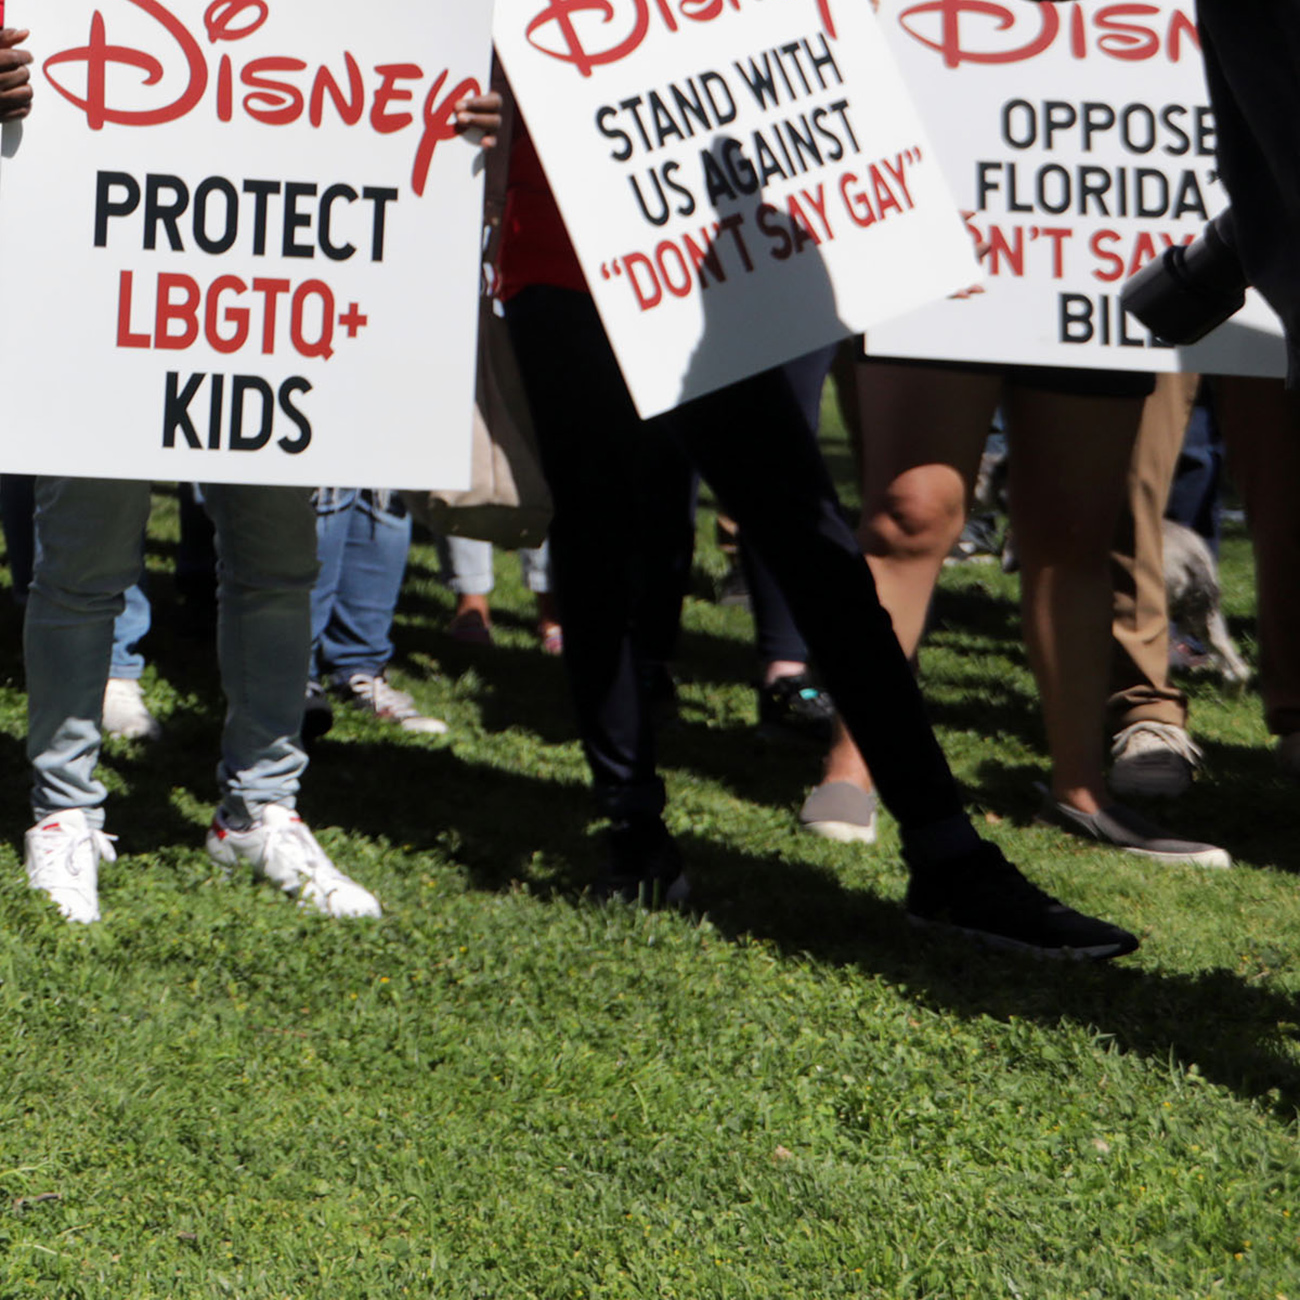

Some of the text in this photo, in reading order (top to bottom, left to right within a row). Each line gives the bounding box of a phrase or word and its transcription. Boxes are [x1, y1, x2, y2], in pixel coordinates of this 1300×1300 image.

[595, 32, 844, 162] STAND WITH
[1001, 99, 1217, 156] OPPOSE
[628, 99, 863, 227] US AGAINST
[975, 161, 1221, 220] FLORIDA'
[94, 170, 399, 262] PROTECT
[601, 146, 923, 311] "DON'T SAY GAY"
[116, 270, 368, 361] LBGTQ+
[162, 371, 313, 455] KIDS
